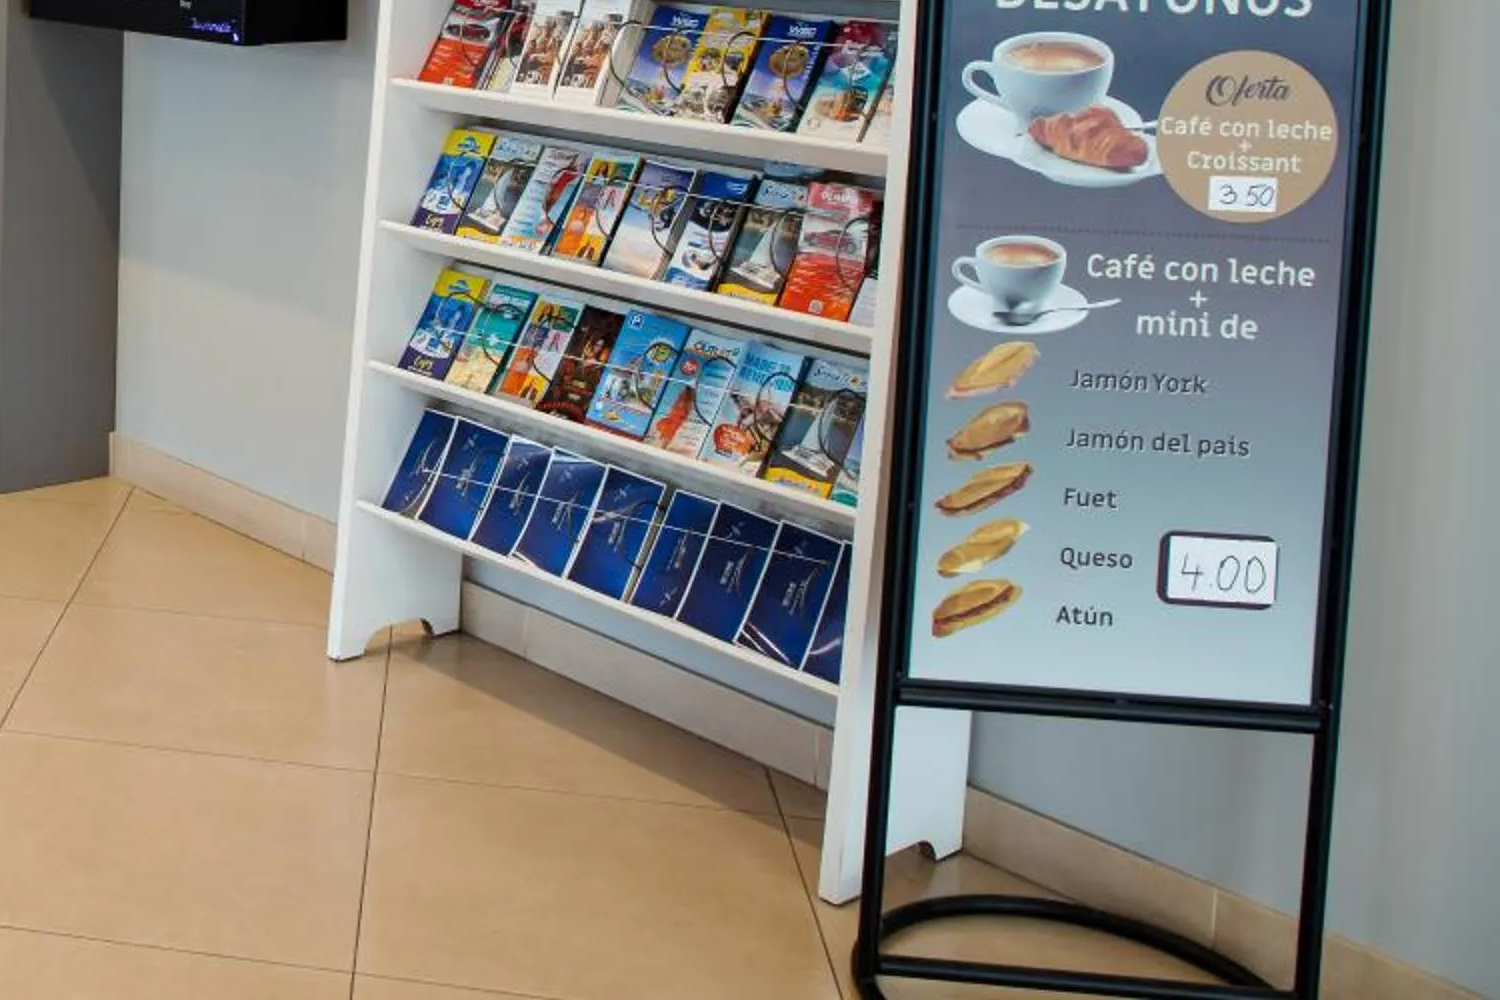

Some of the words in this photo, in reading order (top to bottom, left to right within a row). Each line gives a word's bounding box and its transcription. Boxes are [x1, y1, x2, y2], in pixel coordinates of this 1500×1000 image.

[1205, 75, 1291, 107] Oferta
[1160, 115, 1212, 137] Café
[1219, 121, 1260, 138] con
[1268, 119, 1333, 141] leche
[1186, 150, 1302, 173] Croissant
[1086, 252, 1155, 280] Café
[1164, 260, 1219, 283] con
[1227, 257, 1316, 287] leche
[1135, 309, 1212, 337] mini
[1219, 312, 1259, 340] de
[1069, 364, 1148, 392] Jamón
[1152, 372, 1207, 394] York
[1065, 428, 1144, 452] Jamón
[1151, 432, 1191, 454] del
[1062, 487, 1118, 509] Fuet
[1059, 546, 1134, 571] Queso
[1055, 604, 1114, 627] Atún
